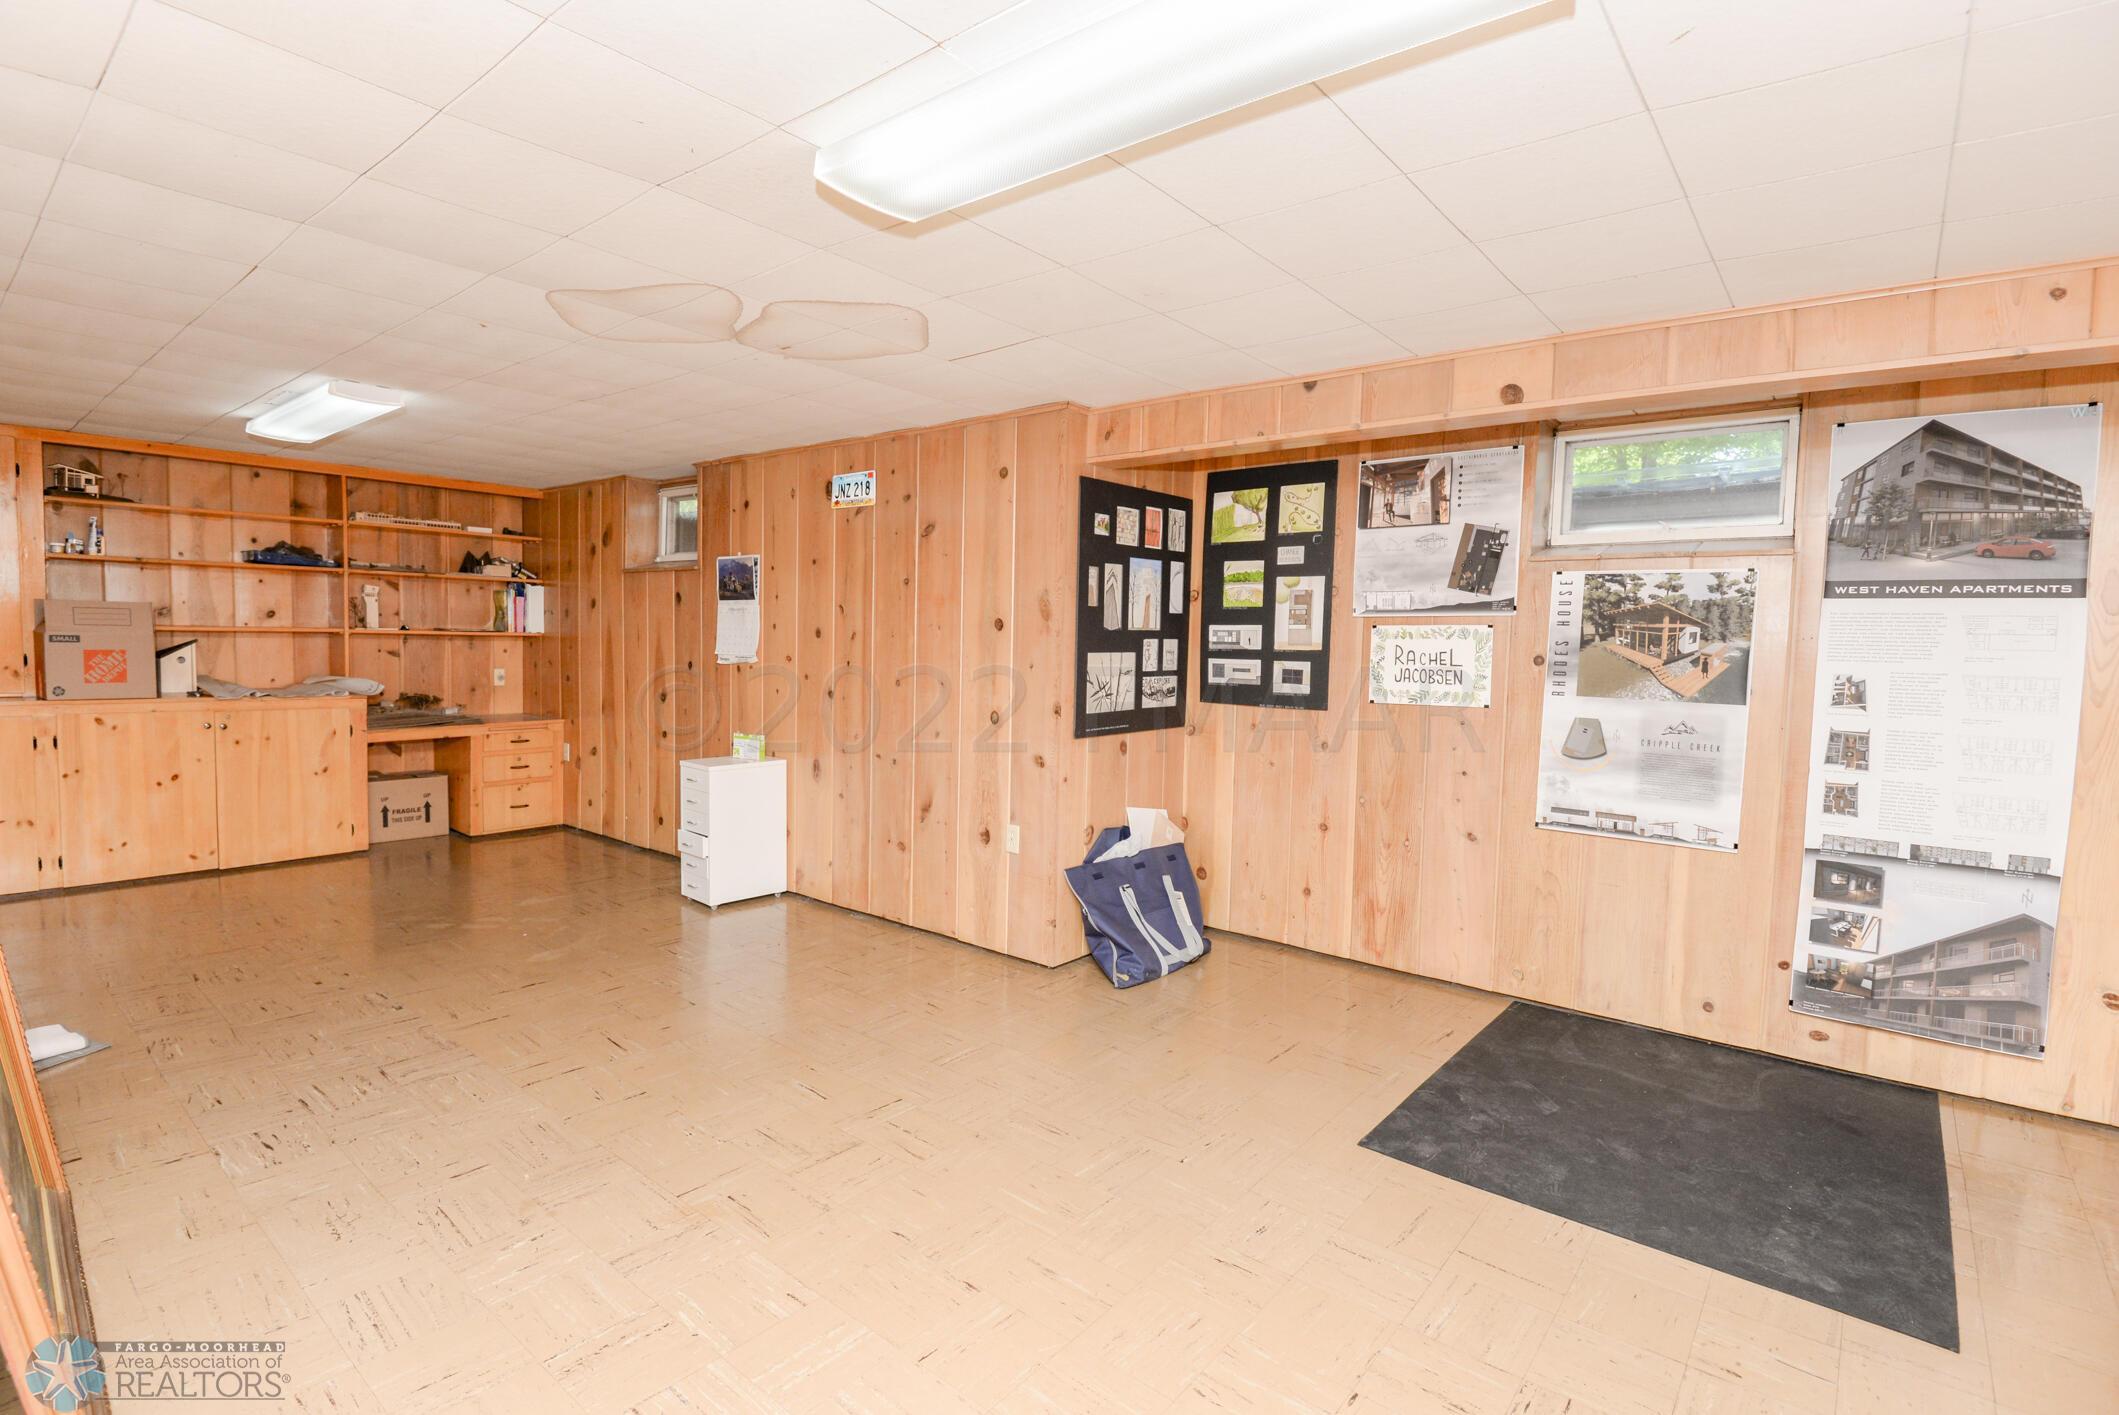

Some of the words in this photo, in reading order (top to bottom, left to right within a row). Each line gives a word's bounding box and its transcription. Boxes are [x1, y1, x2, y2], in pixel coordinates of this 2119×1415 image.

[835, 483, 851, 499] JNZ
[854, 480, 870, 497] 218
[1834, 586, 1880, 595] WEST
[1885, 585, 1944, 594] HAVEN
[1949, 584, 2073, 594] APARTMENTS
[1556, 580, 1573, 627] HOUSE
[1394, 644, 1463, 667] RACHEL
[83, 650, 124, 682] HOME
[1551, 640, 1570, 697] RHODES
[1394, 667, 1464, 685] JACOBSEN
[1640, 738, 1681, 750] CRIPPLE
[1689, 742, 1721, 753] CREEK
[391, 806, 422, 815] FRAGILE
